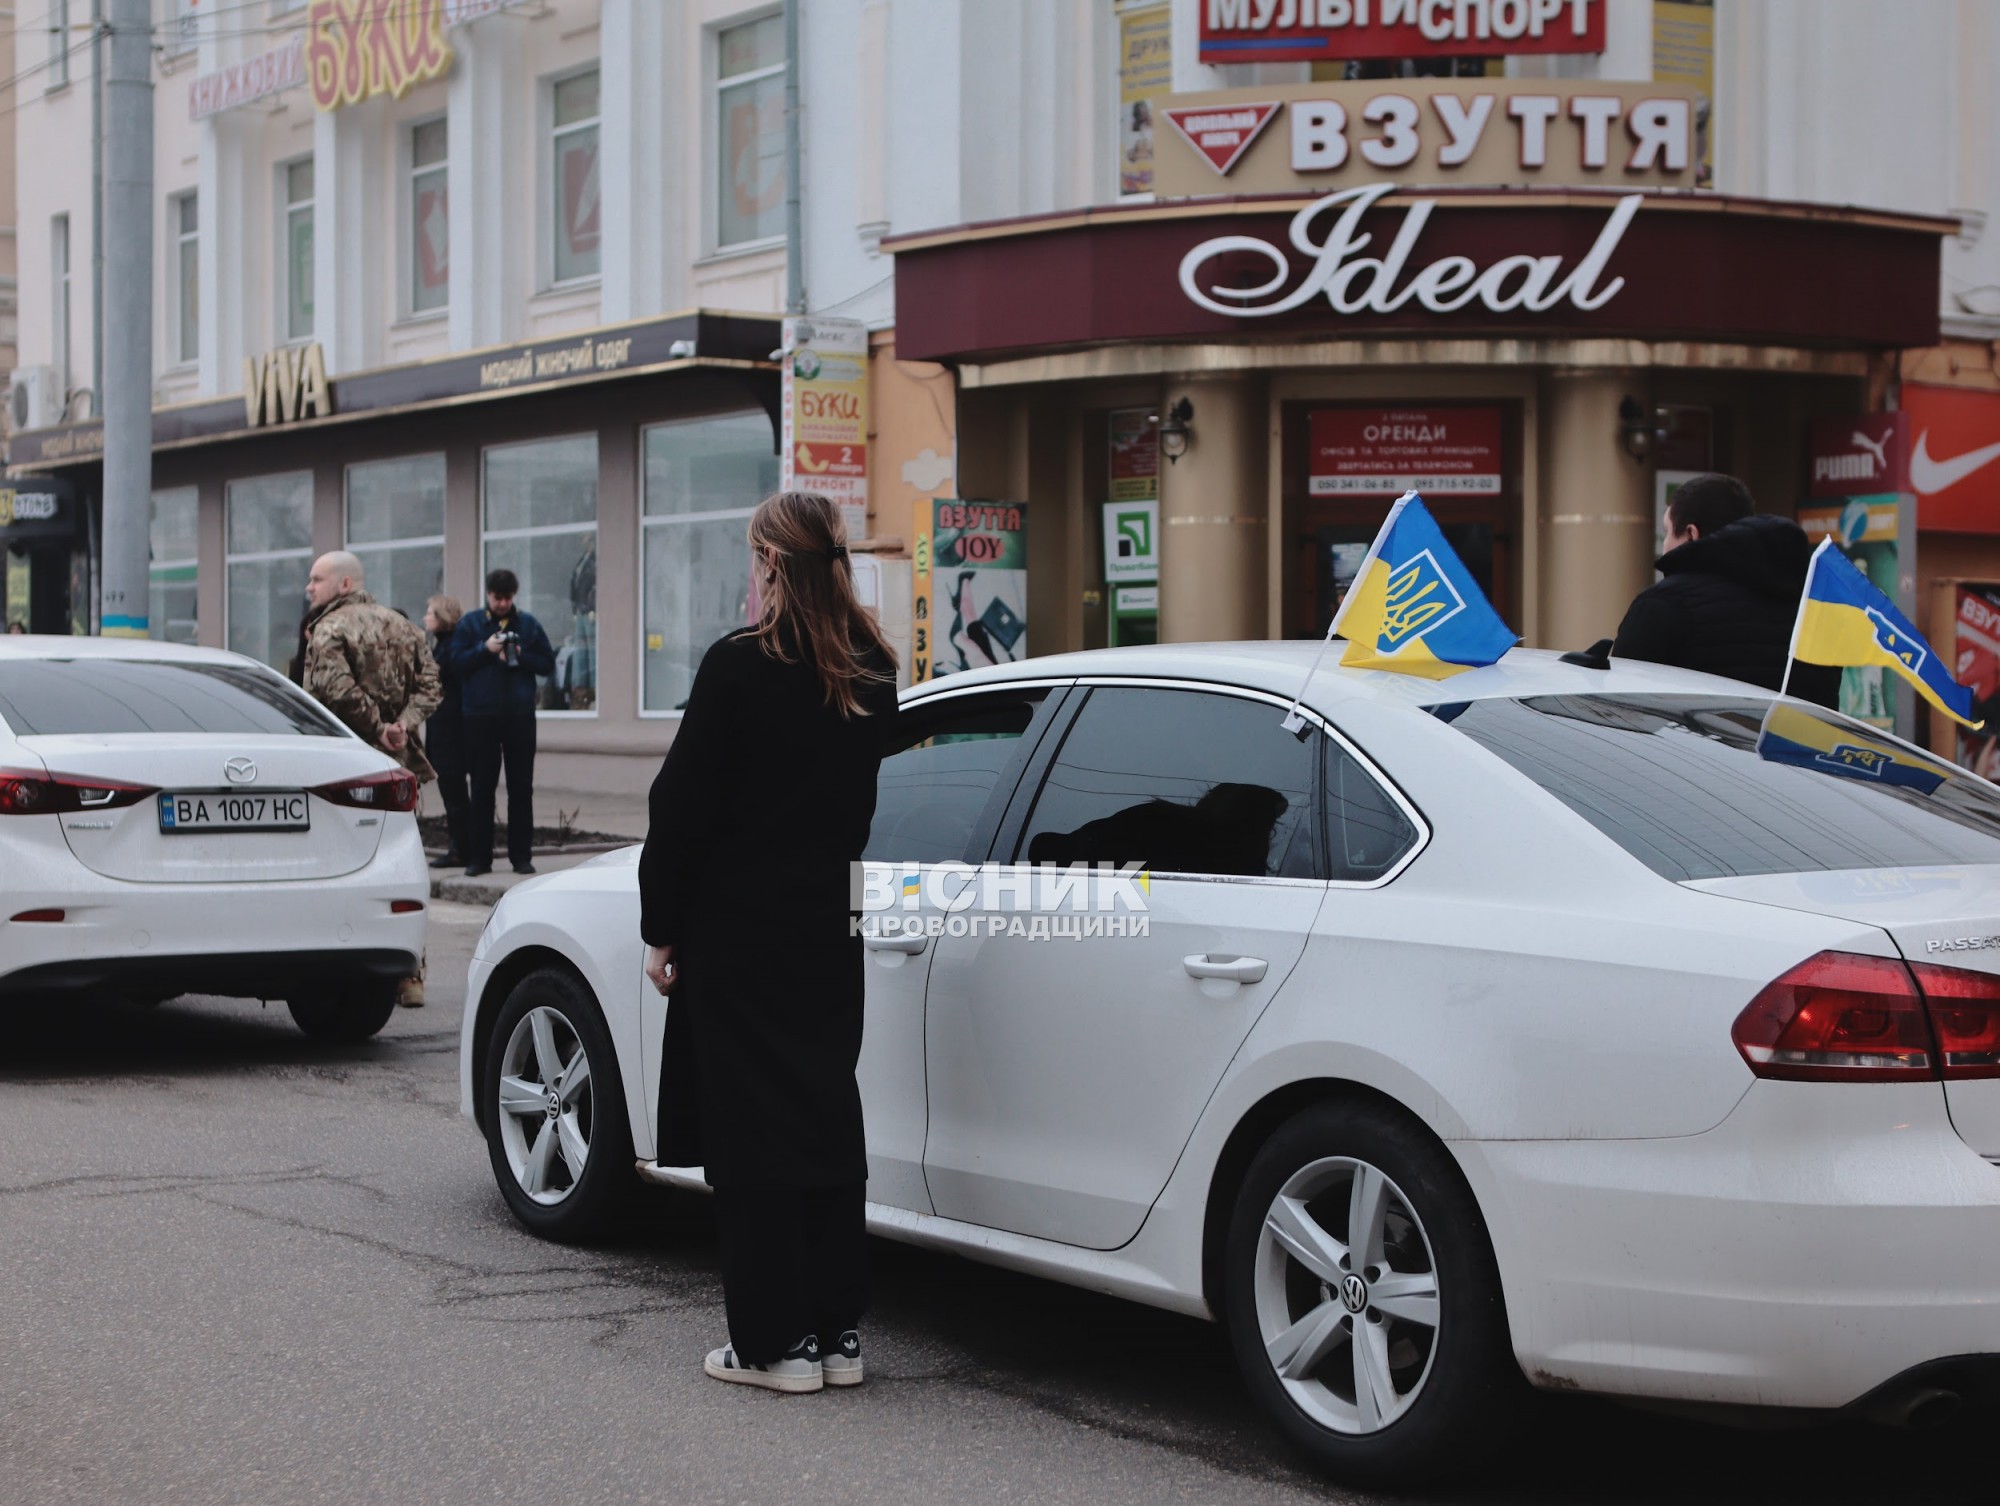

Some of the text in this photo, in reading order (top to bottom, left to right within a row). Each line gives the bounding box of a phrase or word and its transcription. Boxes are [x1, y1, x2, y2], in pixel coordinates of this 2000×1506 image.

[306, 0, 452, 111] БУКИ
[1290, 93, 1690, 173] ВЗУТТЯ
[1179, 182, 1643, 317] Ideal
[480, 338, 632, 388] МОДНИЙ ЖІНОЧИЙ ОДЯГ
[800, 390, 861, 419] БУКИ
[1363, 425, 1447, 442] ОРЕНДИ
[841, 447, 852, 463] 2
[1815, 453, 1875, 481] PUMA
[804, 479, 855, 490] РЕМОНТ
[960, 536, 1001, 562] JOY
[163, 798, 304, 823] UA BA 1007 HC
